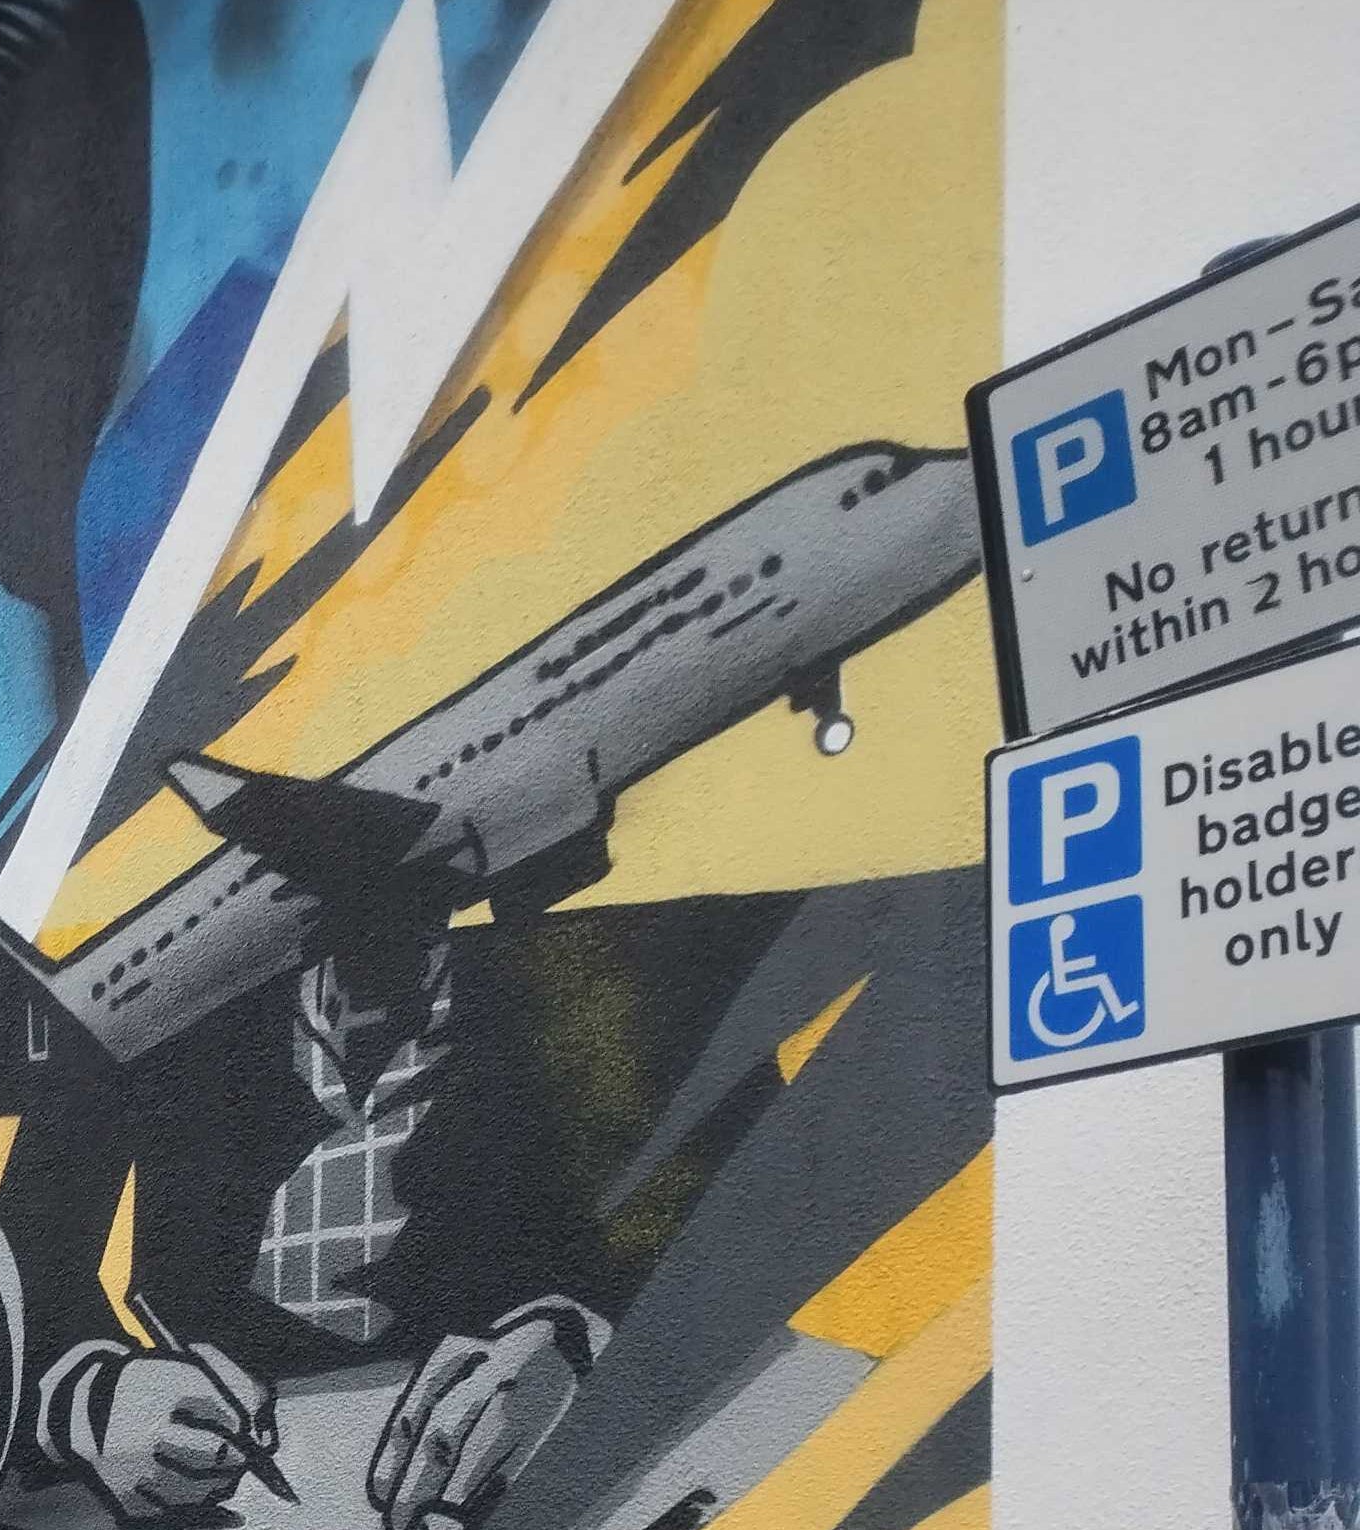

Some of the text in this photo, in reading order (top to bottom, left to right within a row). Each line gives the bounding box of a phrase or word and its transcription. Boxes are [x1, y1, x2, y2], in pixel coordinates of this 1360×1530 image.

[1036, 417, 1105, 526] P
[1204, 443, 1224, 486] 1
[1105, 561, 1176, 612] No
[1070, 595, 1230, 679] within
[1245, 571, 1282, 614] 2
[1041, 762, 1121, 886] P
[1198, 784, 1360, 857] badge
[1181, 846, 1356, 919] holder
[1225, 908, 1343, 967] only
